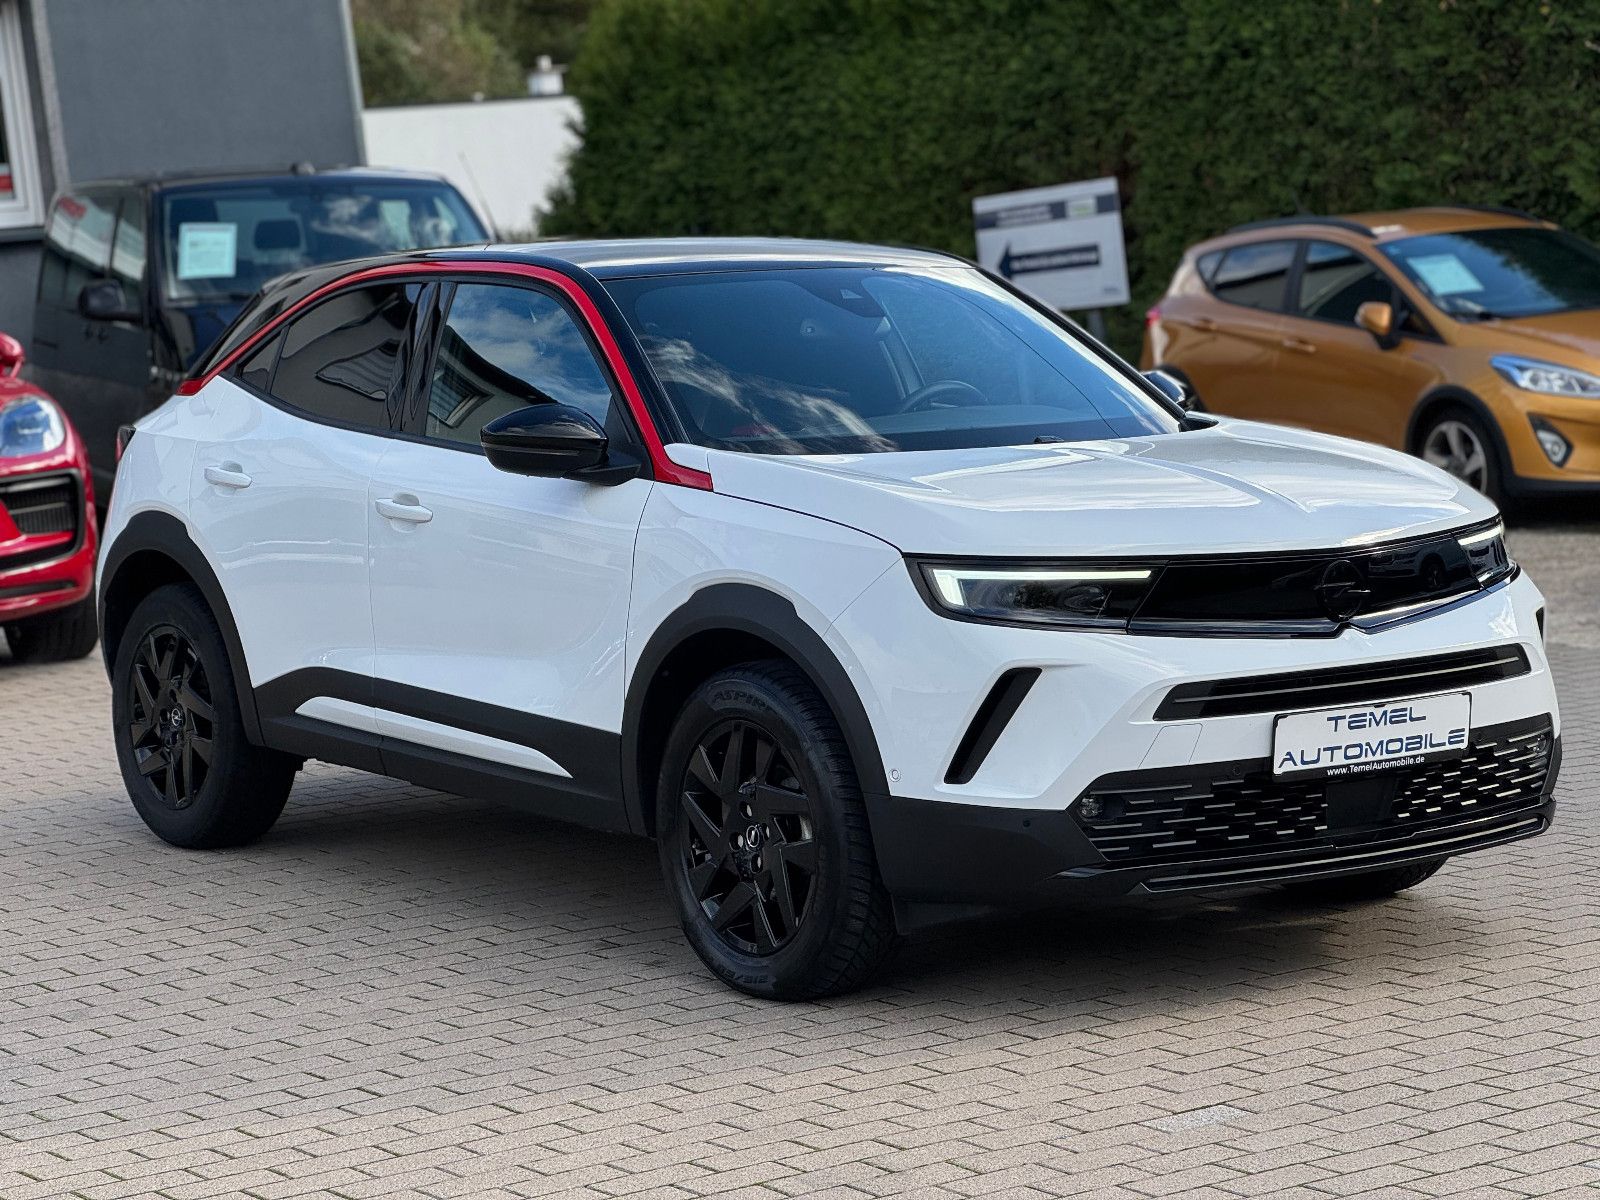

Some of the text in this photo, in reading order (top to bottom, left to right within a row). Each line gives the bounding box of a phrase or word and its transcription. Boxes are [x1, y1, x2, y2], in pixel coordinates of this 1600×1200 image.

[1326, 706, 1427, 733] TEMEL
[1278, 727, 1466, 768] AUTOMOBILE
[1326, 755, 1425, 776] www.TemelAutomobile.de
